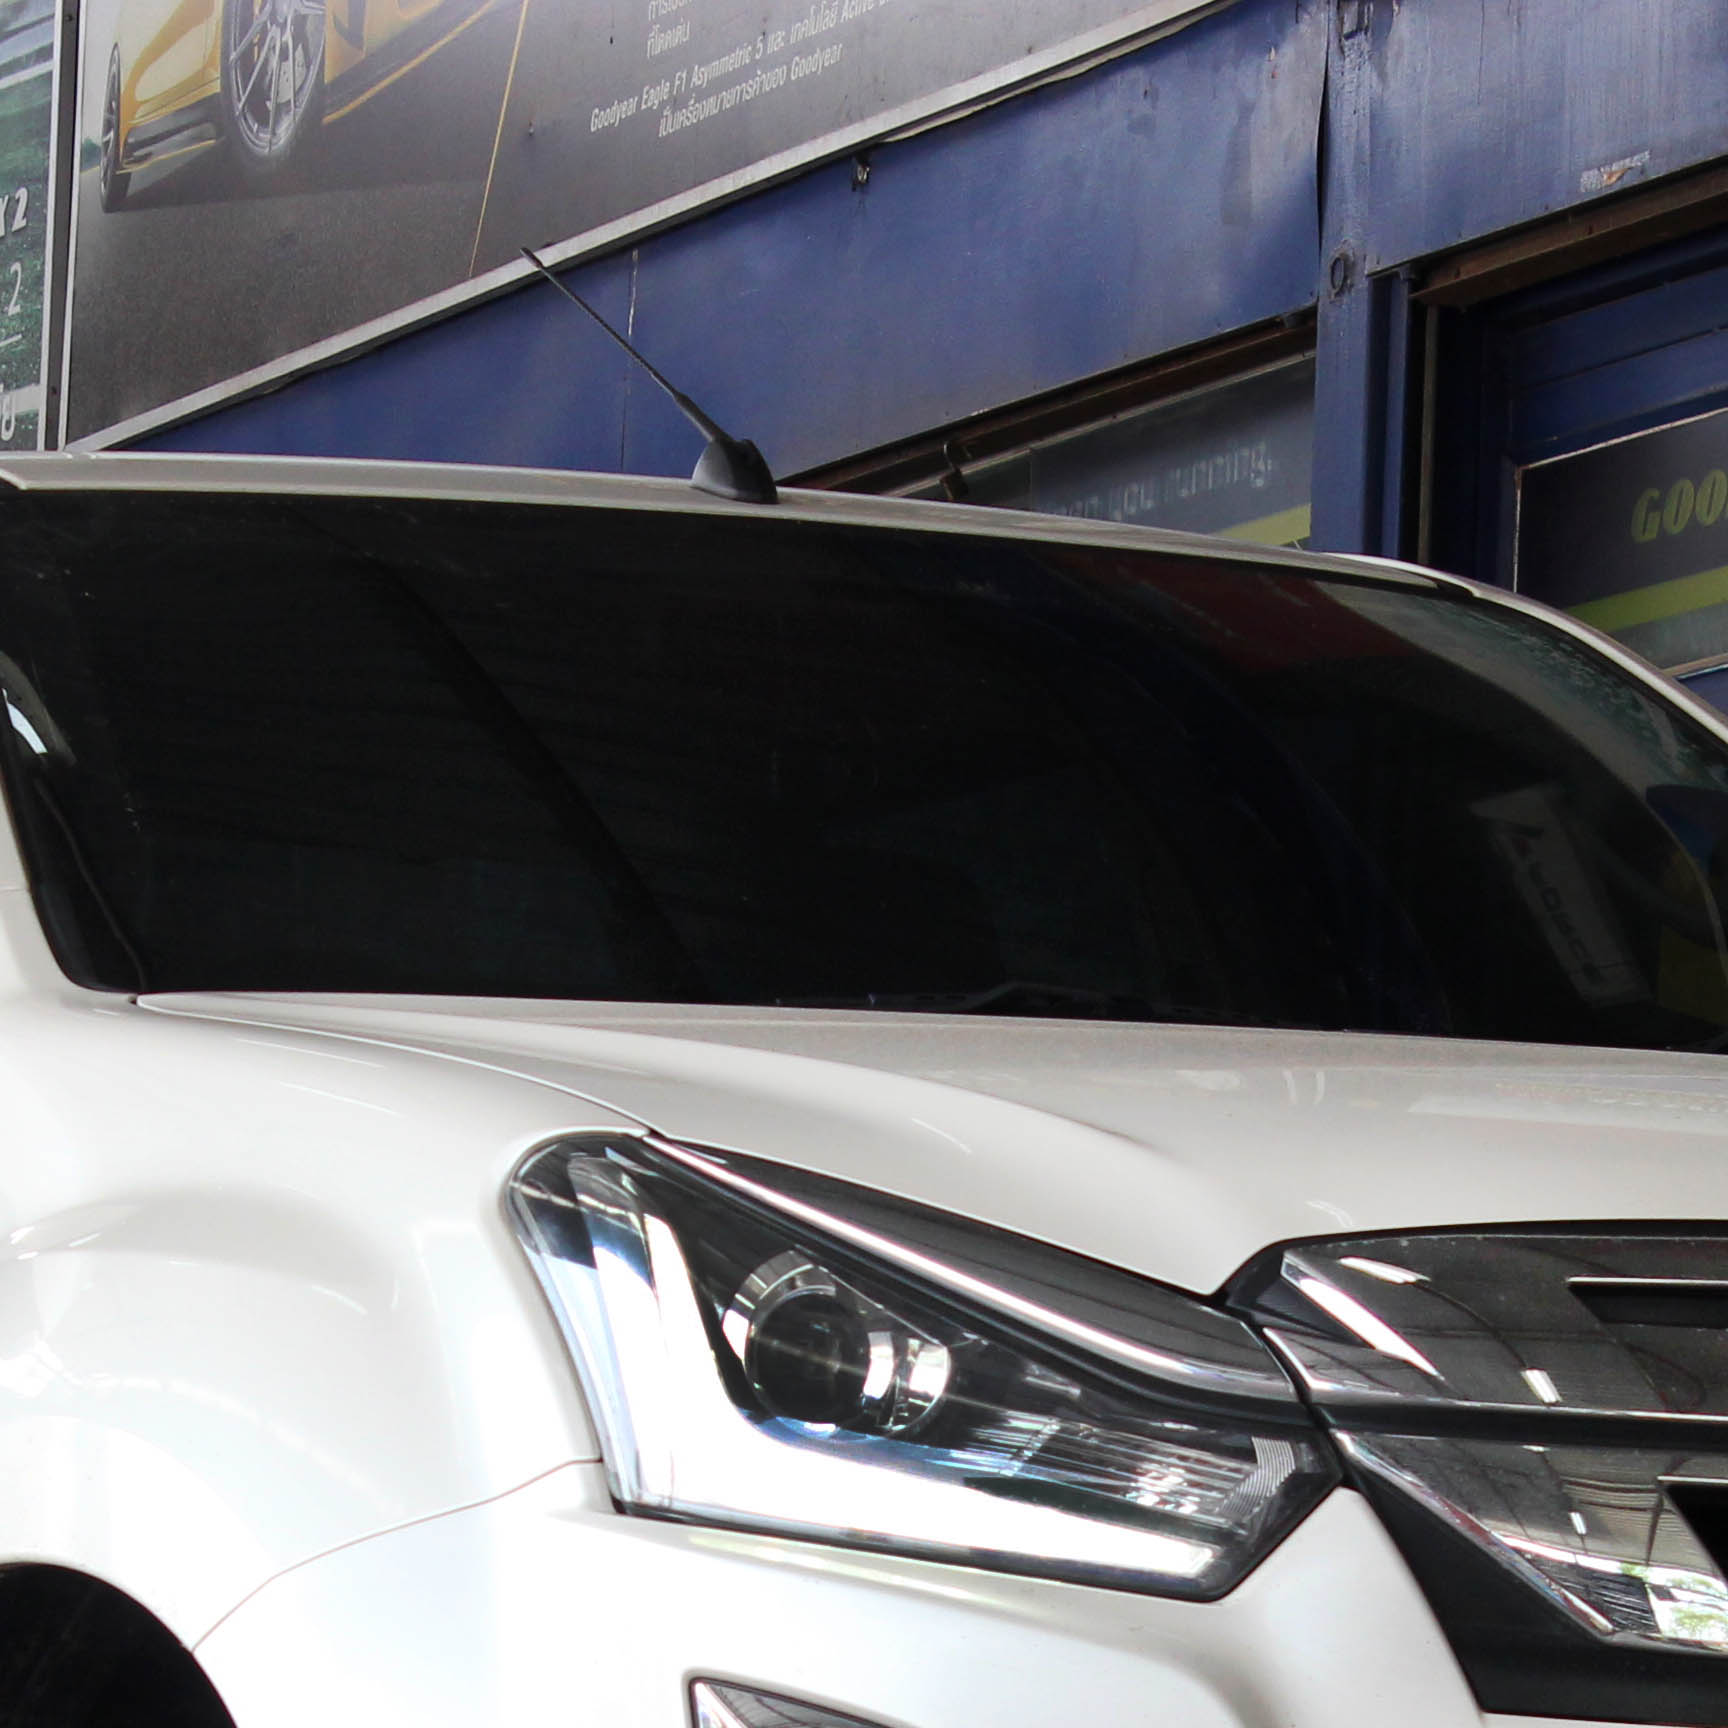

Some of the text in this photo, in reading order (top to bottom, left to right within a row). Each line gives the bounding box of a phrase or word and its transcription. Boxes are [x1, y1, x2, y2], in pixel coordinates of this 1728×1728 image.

[590, 34, 764, 133] Goodyear Eagle F1 Asymmetric 5
[790, 42, 843, 82] Goodyear
[11, 186, 30, 233] 2
[8, 261, 22, 316] 2
